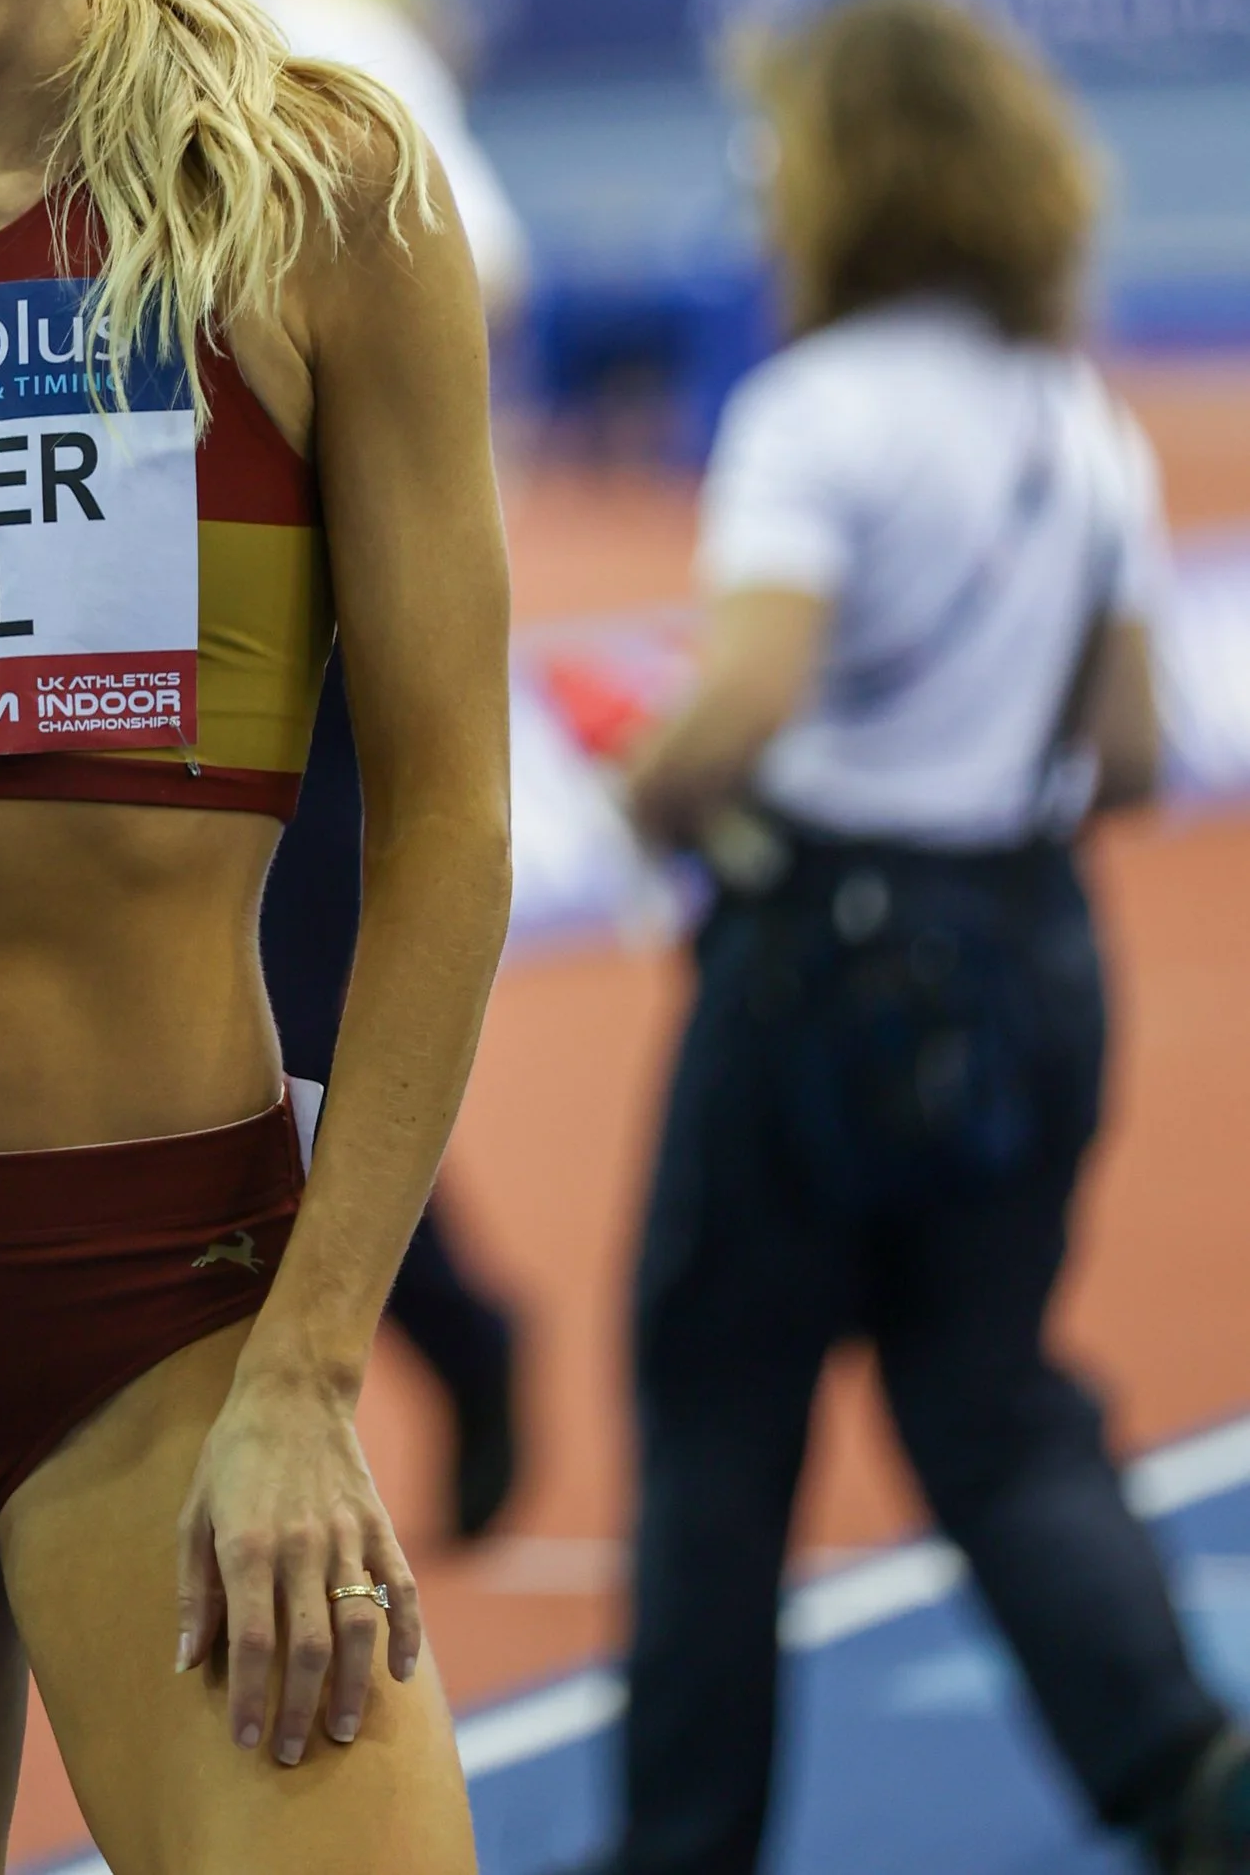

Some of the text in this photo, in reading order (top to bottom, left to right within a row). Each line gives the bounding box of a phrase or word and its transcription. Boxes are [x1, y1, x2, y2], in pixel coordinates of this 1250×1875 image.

[36, 672, 181, 691] UK ATHLETICS
[37, 688, 181, 718] INDOOR
